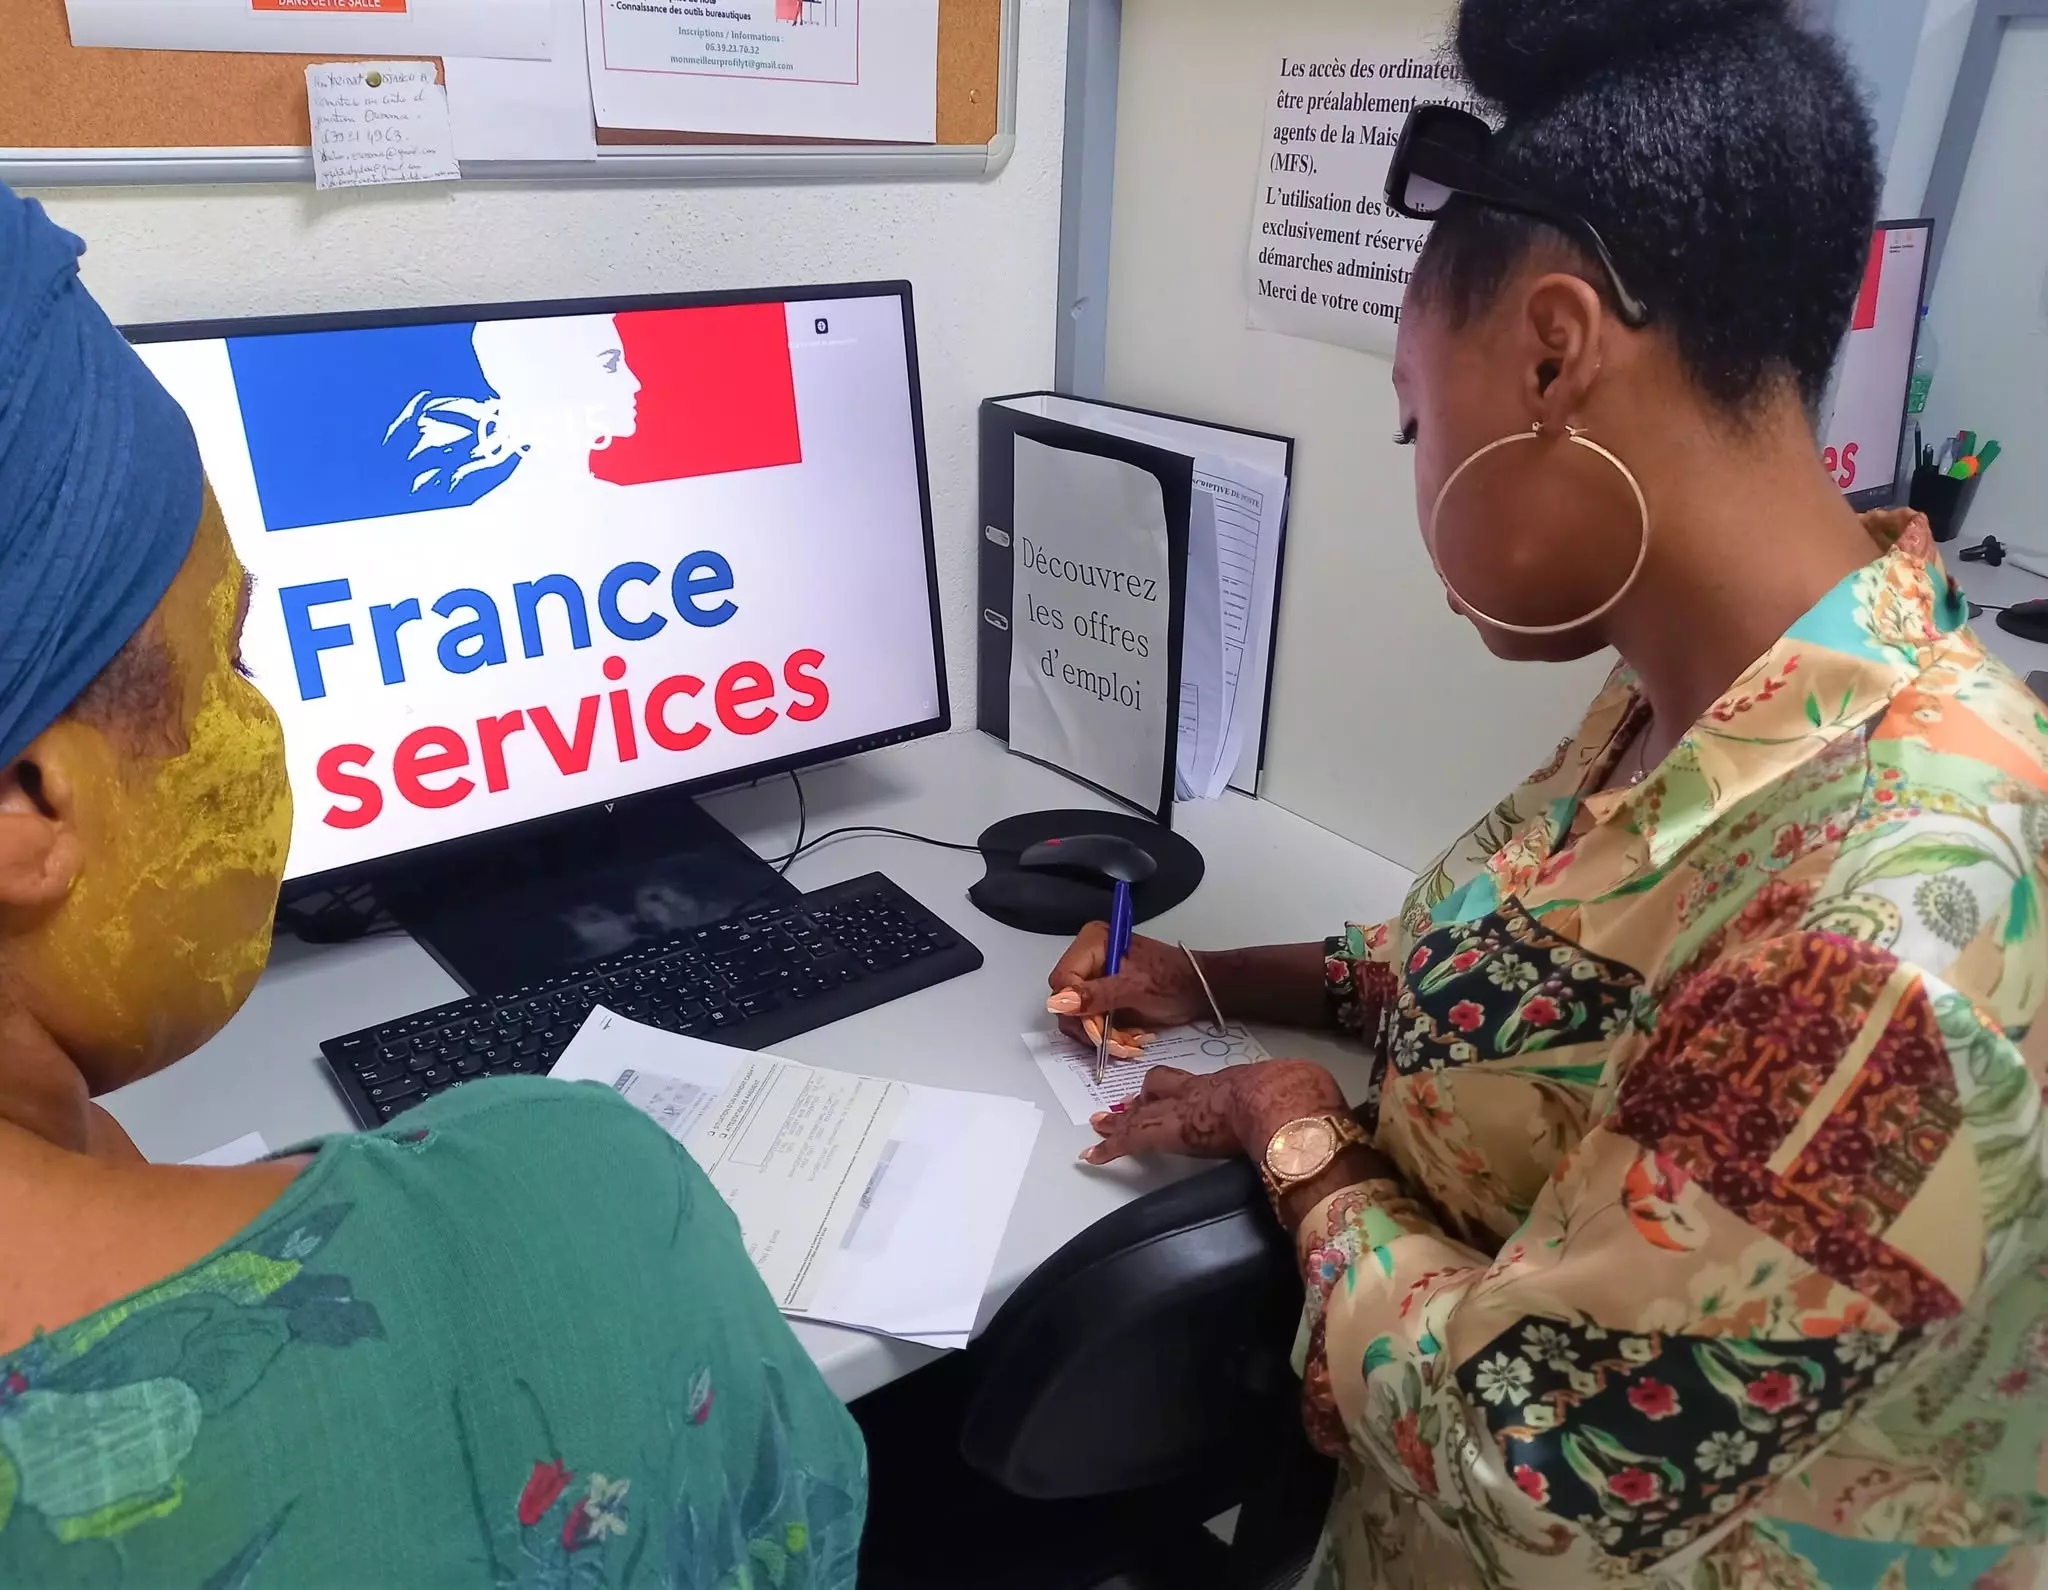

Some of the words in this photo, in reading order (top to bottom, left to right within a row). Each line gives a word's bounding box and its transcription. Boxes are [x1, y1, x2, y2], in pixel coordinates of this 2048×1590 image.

[616, 1, 667, 13] Connaissance
[669, 5, 682, 15] des
[684, 7, 704, 17] outils
[705, 9, 751, 21] bureautiques
[678, 26, 724, 39] Inscriptions
[731, 30, 780, 43] Informations
[1280, 58, 1305, 78] Les
[1309, 57, 1346, 79] accès
[1350, 58, 1375, 79] des
[1276, 90, 1303, 112] être
[1306, 91, 1417, 115] préalablement
[1273, 124, 1317, 146] agents
[1320, 124, 1337, 143] de
[1341, 124, 1355, 144] la
[1359, 125, 1398, 147] Mais
[1269, 152, 1317, 177] (MFS).
[1266, 186, 1352, 213] L'utilisation
[1356, 196, 1381, 217] des
[1262, 219, 1361, 247] exclusivement
[1365, 230, 1424, 254] réservé
[1258, 247, 1333, 274] démarches
[1337, 261, 1412, 285] administr
[1257, 278, 1297, 302] Merci
[1300, 286, 1318, 305] de
[1321, 293, 1358, 312] votre
[1362, 299, 1403, 324] comp
[1021, 536, 1158, 602] Découvrez
[278, 549, 739, 701] France
[1027, 593, 1064, 631] les
[1073, 609, 1149, 658] offres
[1040, 648, 1142, 712] d'emploi
[316, 648, 829, 830] services
